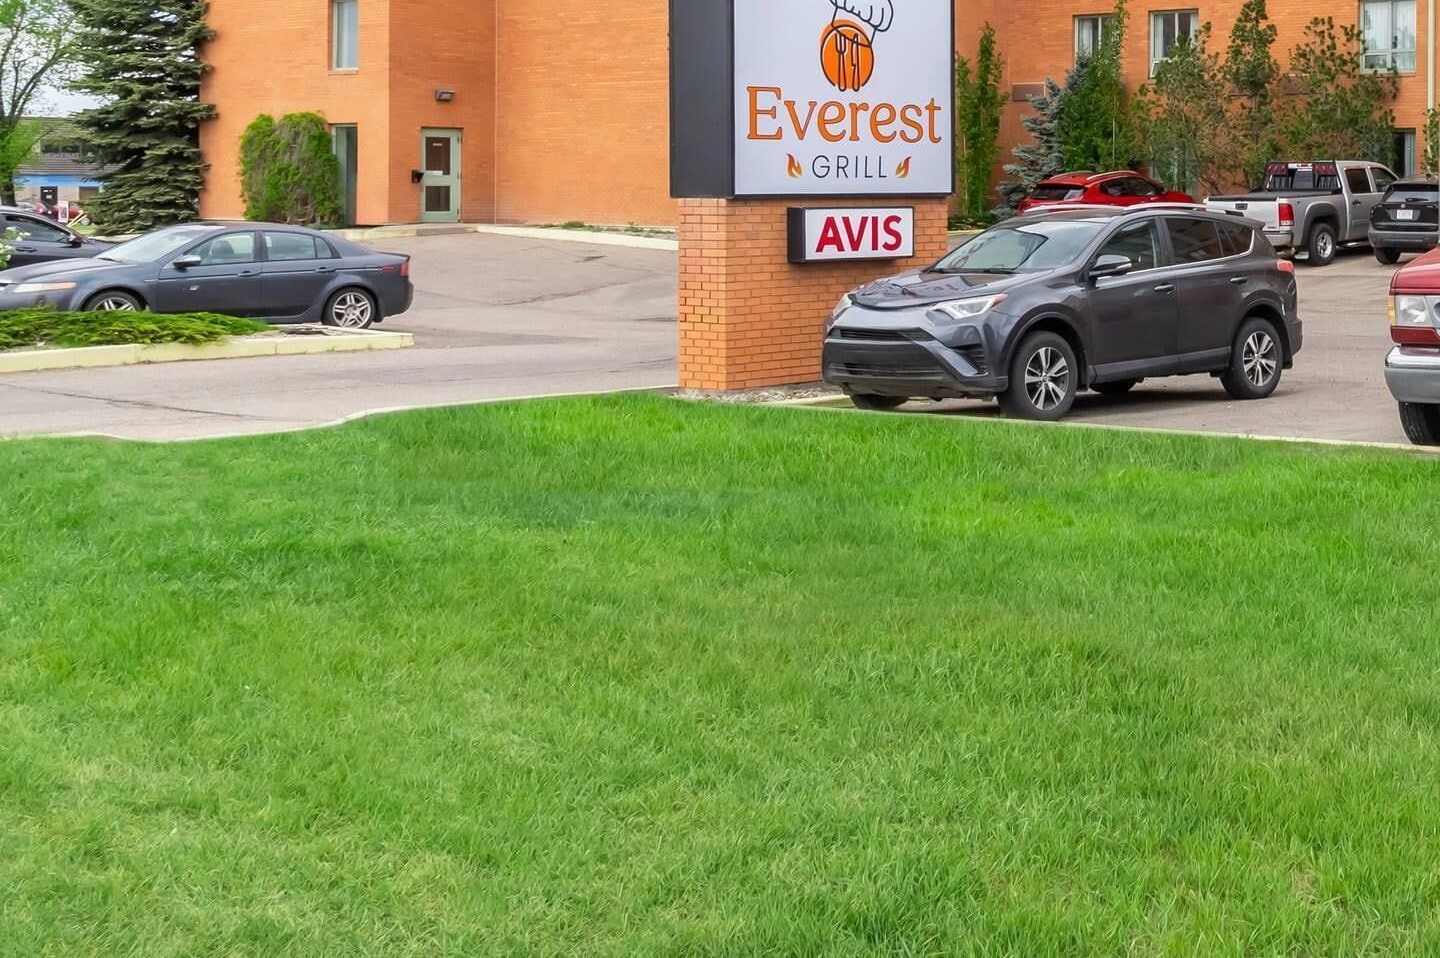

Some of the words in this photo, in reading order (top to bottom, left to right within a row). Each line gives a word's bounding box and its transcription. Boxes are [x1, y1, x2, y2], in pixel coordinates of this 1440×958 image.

[746, 85, 942, 143] Everest
[811, 154, 887, 178] GRILL
[815, 214, 902, 253] AVIS
